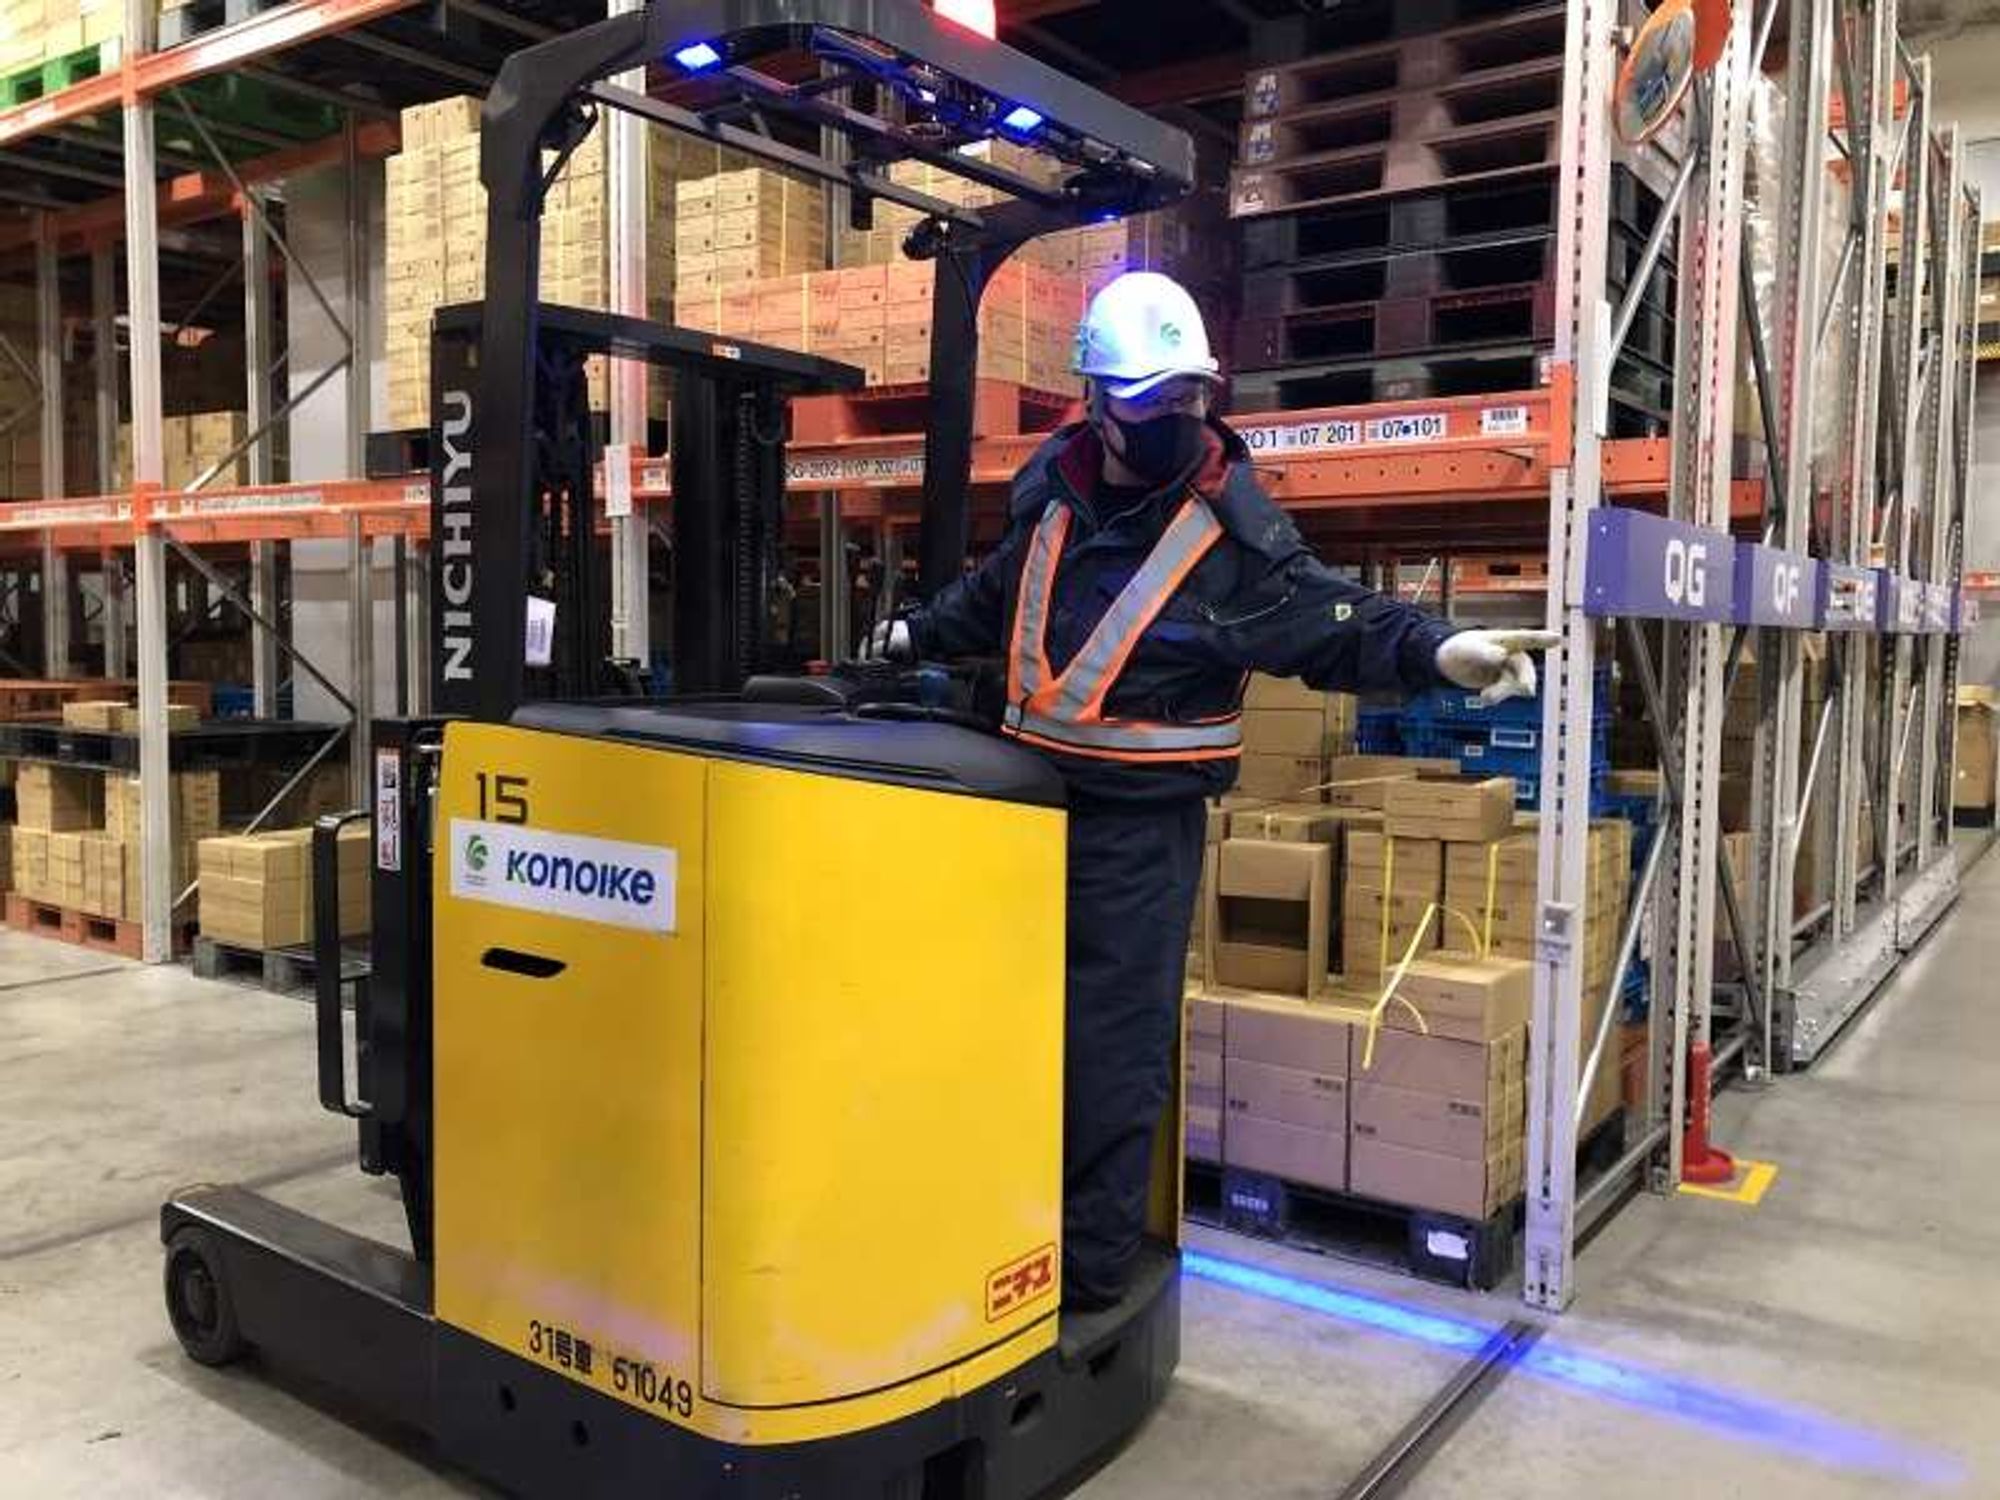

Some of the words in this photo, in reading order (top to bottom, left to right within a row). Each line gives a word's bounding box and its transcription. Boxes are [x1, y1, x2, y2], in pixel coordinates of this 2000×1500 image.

[1327, 424, 1355, 443] 201
[442, 390, 473, 681] NICHIYU
[1665, 539, 1706, 606] QG
[1773, 563, 1800, 615] QF
[476, 773, 528, 825] 15
